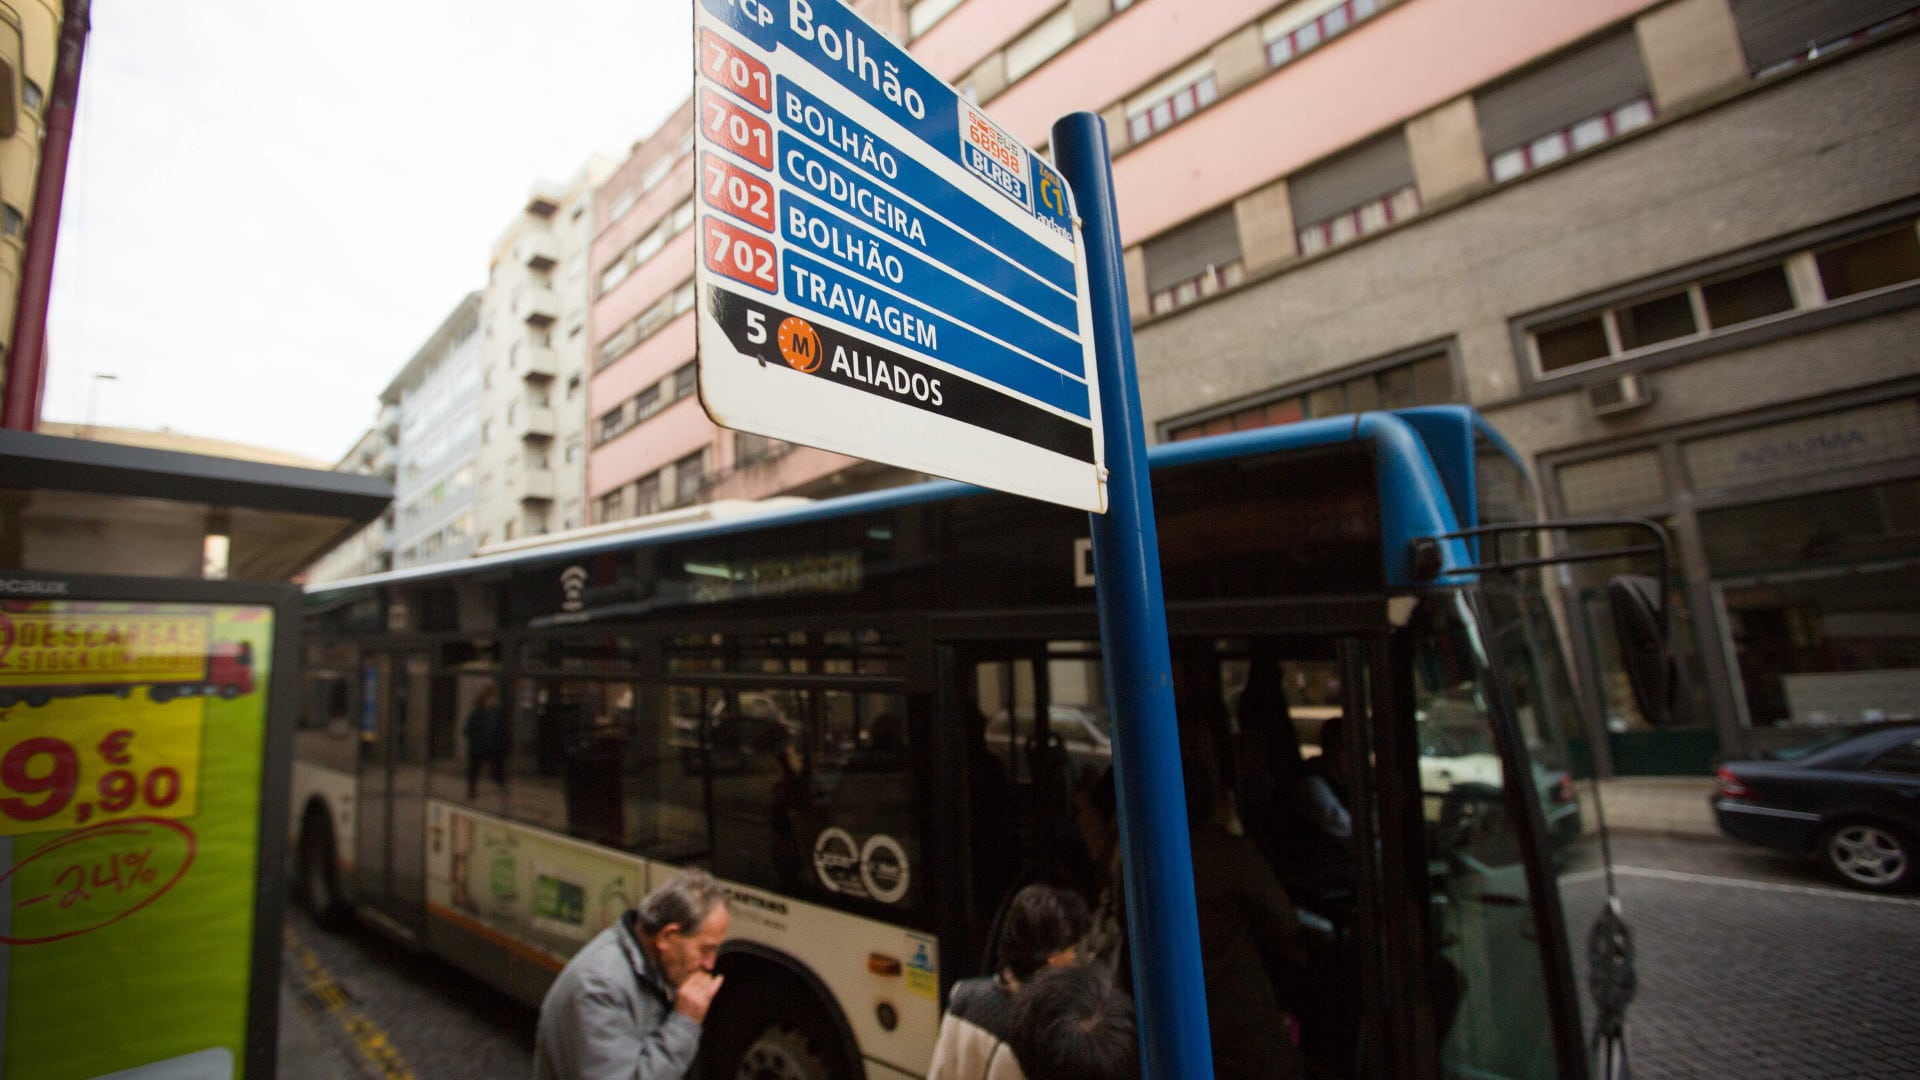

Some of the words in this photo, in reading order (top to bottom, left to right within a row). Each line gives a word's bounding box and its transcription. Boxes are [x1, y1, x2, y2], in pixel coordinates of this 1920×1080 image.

[728, 0, 774, 28] CP
[789, 0, 926, 120] Bolhão
[708, 43, 767, 101] 701
[785, 91, 898, 180] BOLHÃO
[970, 125, 1019, 174] 68998
[705, 164, 769, 220] 702
[788, 205, 904, 284] BOLHÃO
[707, 101, 767, 158] 701
[786, 150, 927, 247] CODICEIRA
[972, 148, 1022, 199] BLRB3
[1040, 178, 1064, 217] C1
[710, 229, 775, 283] 702
[790, 264, 938, 351] TRAVAGEM
[745, 308, 768, 345] 5
[791, 333, 810, 358] M
[830, 345, 943, 407] ALIADOS
